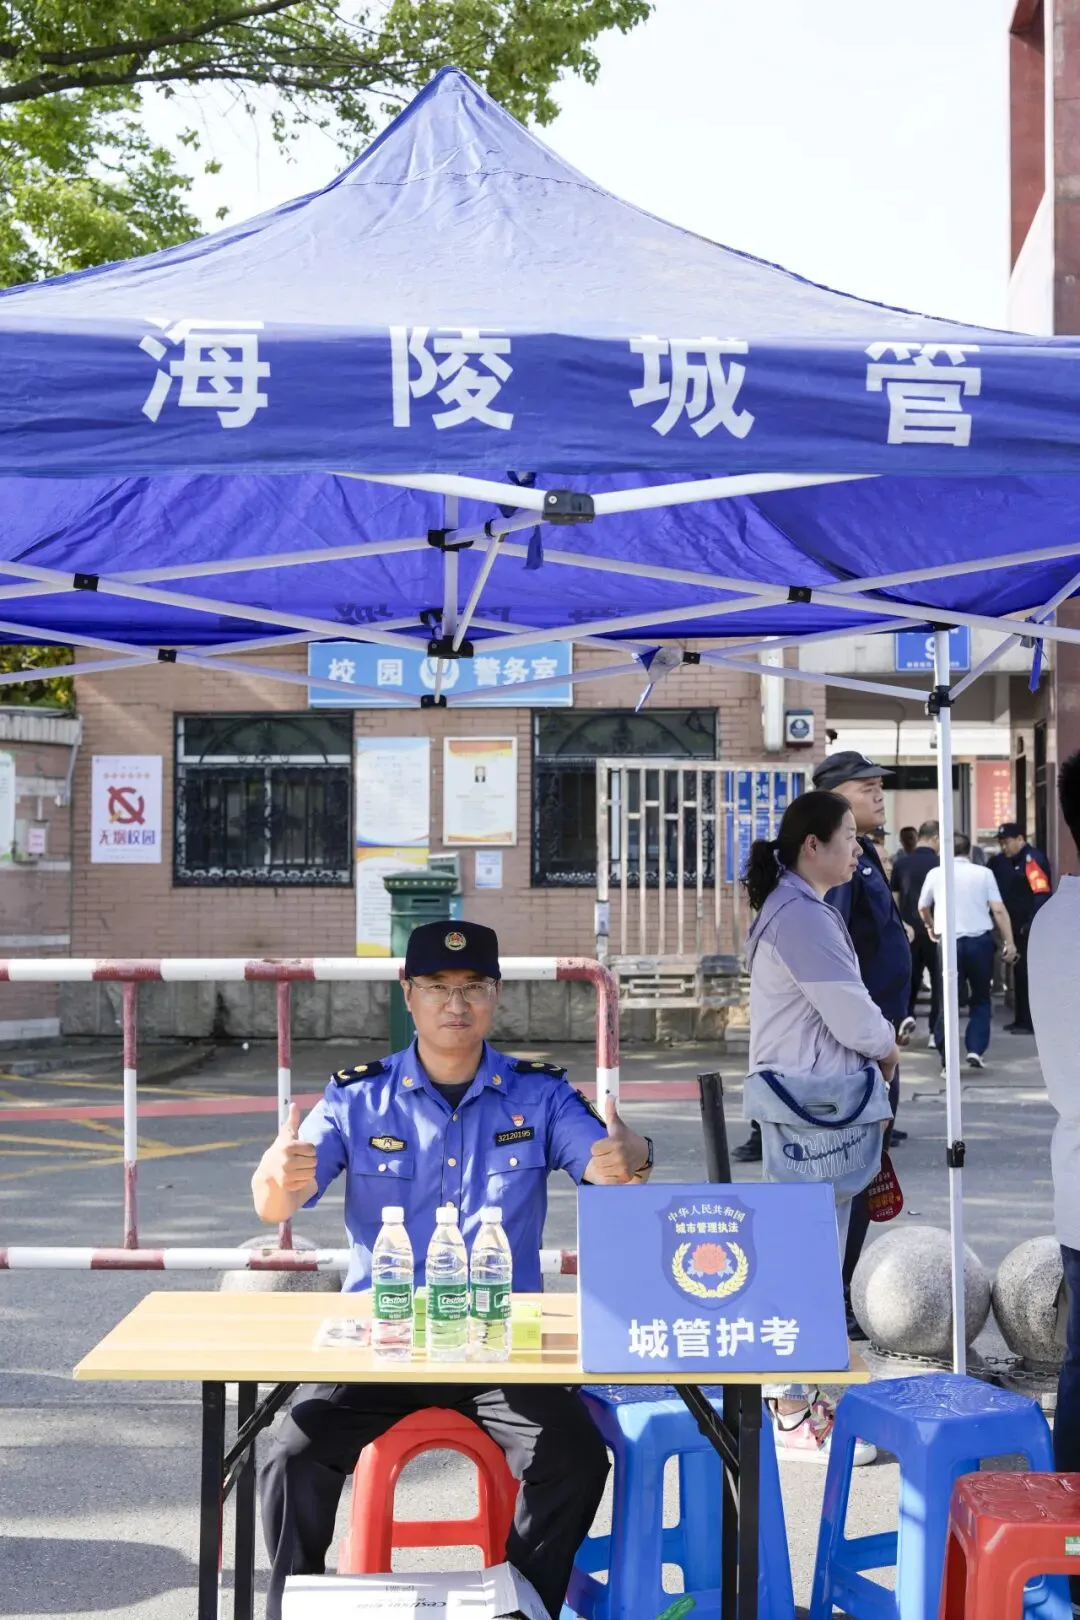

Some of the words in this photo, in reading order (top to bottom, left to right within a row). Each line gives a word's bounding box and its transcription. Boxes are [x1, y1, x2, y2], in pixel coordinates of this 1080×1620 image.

[139, 318, 982, 447] 海陵城管
[328, 658, 403, 686] 校园
[473, 657, 558, 686] 警务室
[667, 1203, 746, 1223] 中华人民共和国
[675, 1221, 740, 1234] 城市管理执法
[628, 1317, 800, 1359] 城管护考
